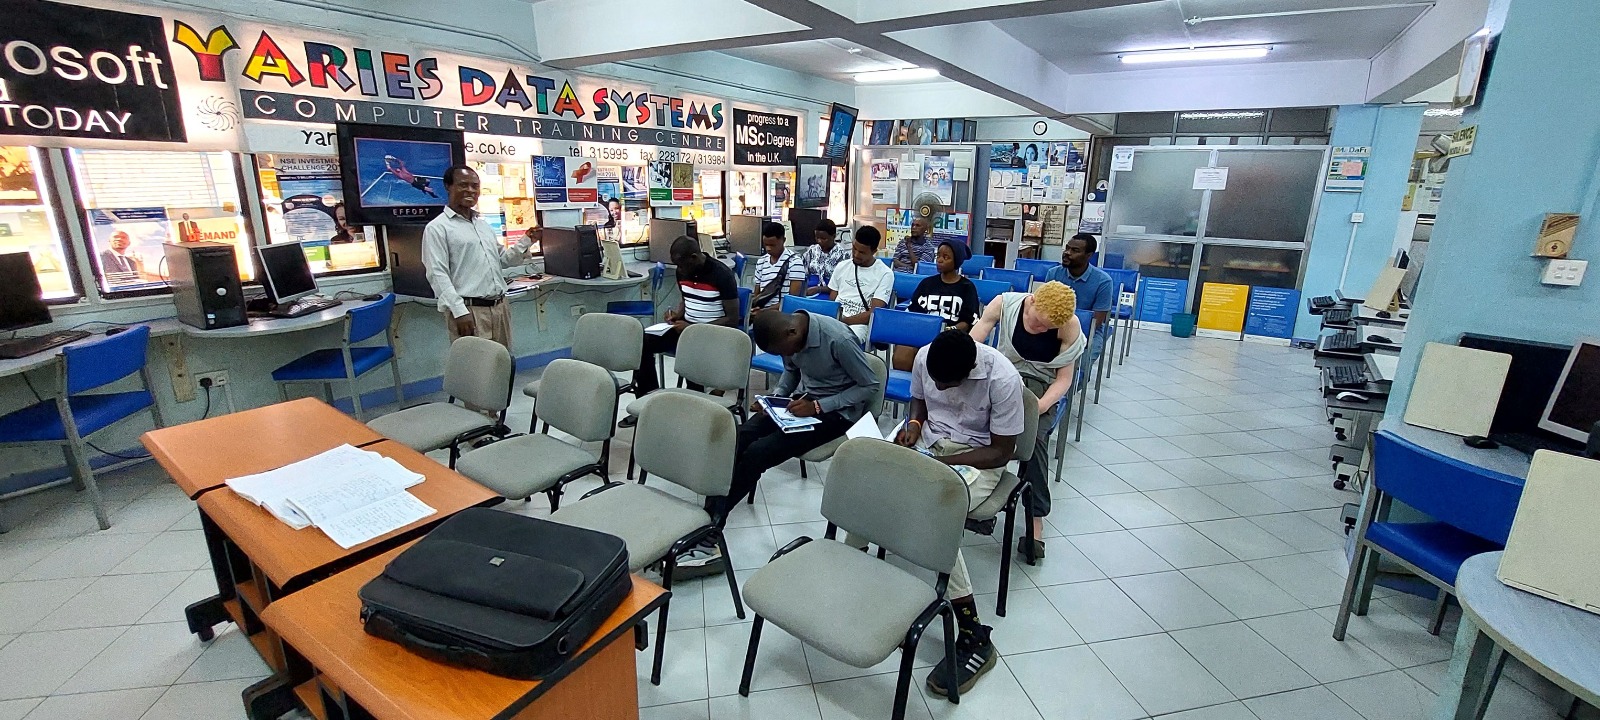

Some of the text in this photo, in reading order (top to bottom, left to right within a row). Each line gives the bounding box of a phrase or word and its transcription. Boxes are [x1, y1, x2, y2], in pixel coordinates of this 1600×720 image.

[173, 19, 724, 130] YARIES DATA SYSTEMS
[0, 103, 132, 134] TODAY
[254, 94, 723, 149] COMPUTER TRAINING CENTRE
[747, 113, 789, 126] progress to a
[736, 124, 795, 148] MSc Degree
[569, 145, 583, 157] tel
[589, 147, 628, 160] 315995
[640, 151, 654, 161] fax
[659, 151, 691, 163] 228172
[697, 153, 726, 166] 313984
[747, 151, 782, 163] in the U.K.
